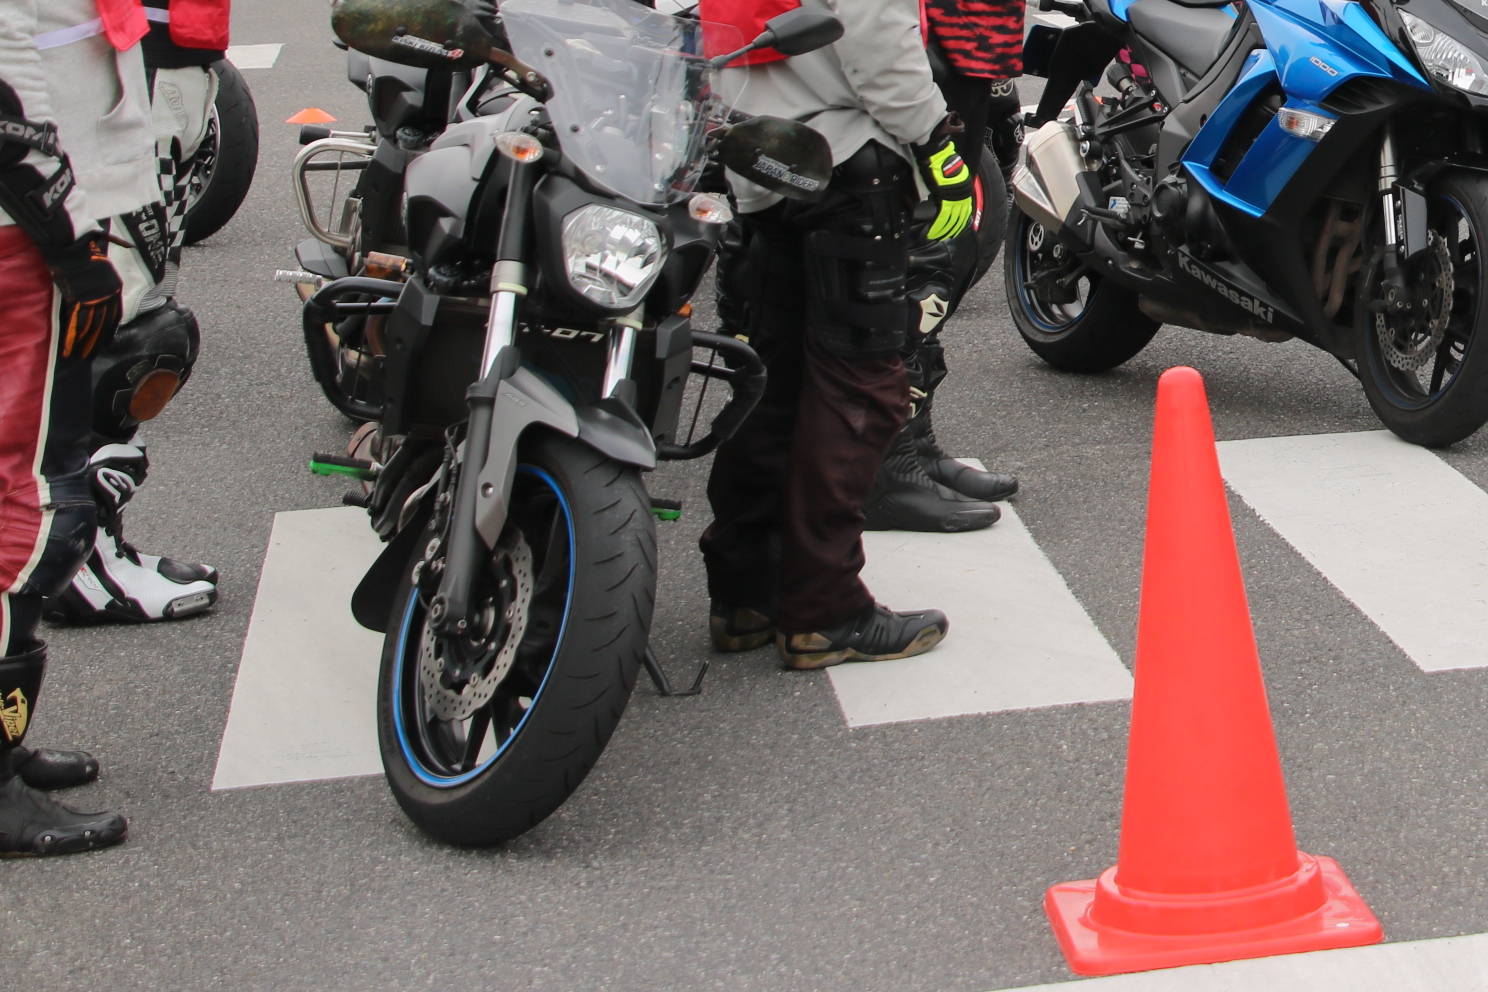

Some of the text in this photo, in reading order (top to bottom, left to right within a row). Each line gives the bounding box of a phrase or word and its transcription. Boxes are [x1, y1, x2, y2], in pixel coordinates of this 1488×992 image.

[1309, 55, 1338, 77] 1000
[754, 160, 785, 178] JAPAN
[789, 175, 820, 191] RIDERS
[1178, 251, 1274, 324] Kawasaki
[7, 703, 20, 738] Viper
